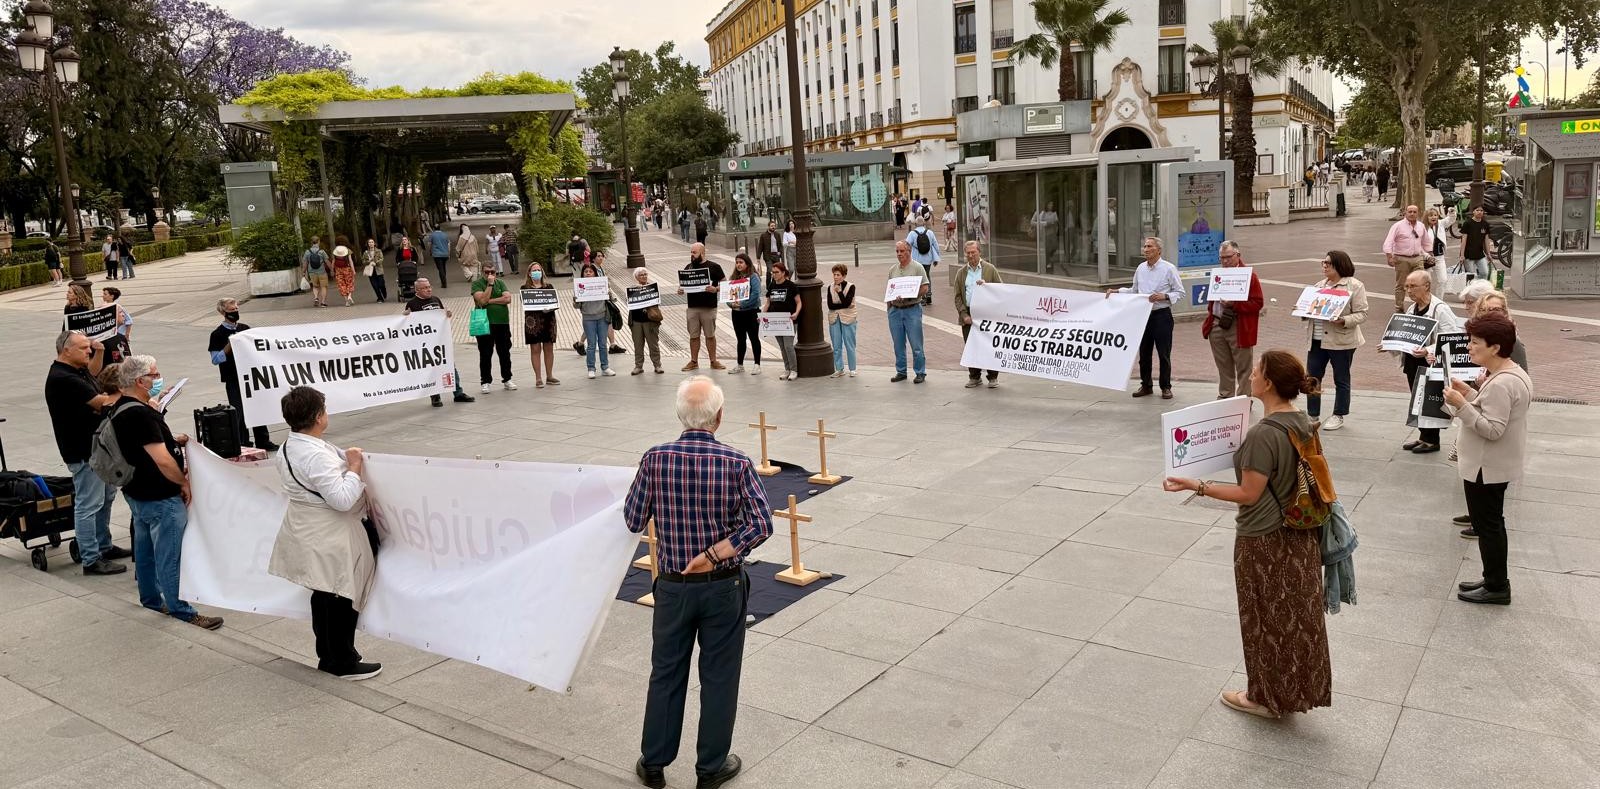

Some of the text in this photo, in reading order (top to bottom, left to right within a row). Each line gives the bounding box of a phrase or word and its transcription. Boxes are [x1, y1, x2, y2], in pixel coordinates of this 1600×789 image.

[1027, 110, 1036, 121] P
[86, 322, 106, 334] MUERTO
[979, 319, 991, 332] EL
[993, 321, 1050, 339] TRABAJO
[1050, 328, 1064, 340] ES
[1066, 328, 1128, 351] SEGURO,
[254, 323, 437, 352] El trabajo es para la vida.
[992, 335, 1103, 362] O NO ES TRABAJO
[243, 342, 447, 398] ¡NI UN MUERTO MÁS!
[994, 351, 1003, 360] NO
[1013, 353, 1062, 368] SINIESTRALIDAD
[1062, 359, 1091, 373] LABORAL
[1017, 362, 1038, 373] SALUD
[1045, 365, 1051, 374] el
[1051, 366, 1080, 380] TRABAJO
[383, 384, 420, 396] siniestralidad
[1190, 424, 1240, 440] cuidar el trabajo
[1190, 438, 1210, 446] cuidar
[1217, 432, 1230, 440] vida
